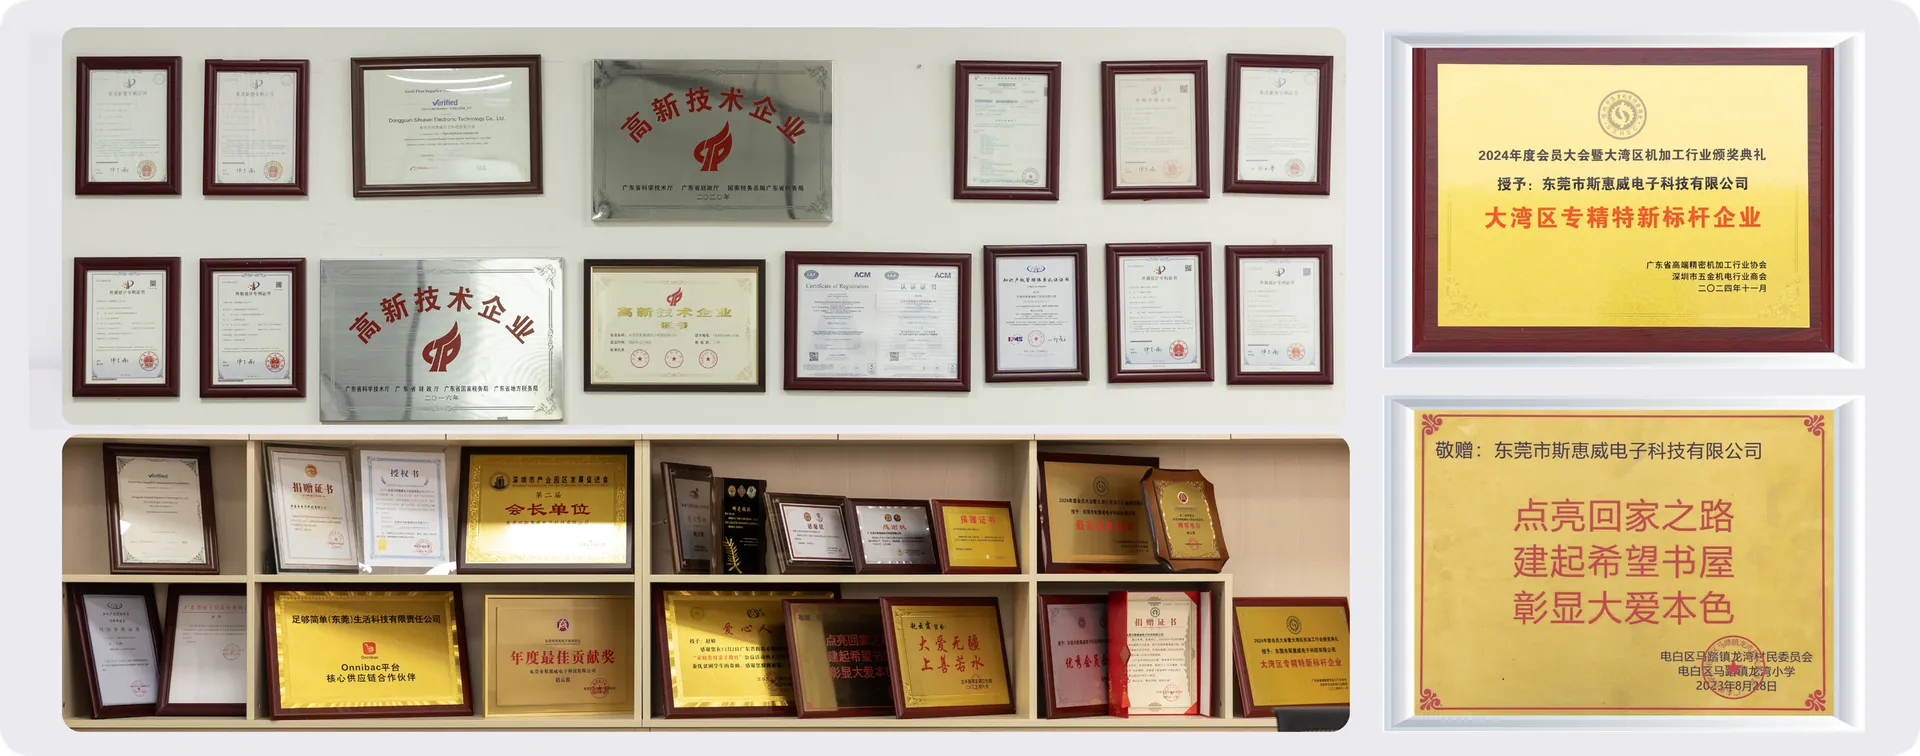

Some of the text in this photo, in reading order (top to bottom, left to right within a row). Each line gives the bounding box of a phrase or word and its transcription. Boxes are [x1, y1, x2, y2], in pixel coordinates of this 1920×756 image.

[620, 86, 806, 145] 高新技术企业
[1478, 148, 1767, 162] 2024年度会员大会暨大湾区机加工行业颁奖典礼
[1484, 206, 1762, 230] 大湾区专精特新标杆企业
[1646, 260, 1767, 270] 广东省高端精密机加工行业协会
[1672, 272, 1767, 281] 深圳市五金机电行业商会
[349, 285, 535, 345] 高新技术企业
[617, 306, 733, 318] 高新技术企业
[390, 468, 420, 478] 授权书
[292, 481, 334, 495] 捐赠证书
[505, 503, 591, 516] 会长单位
[1513, 498, 1735, 533] 点亮回家之路
[1513, 544, 1735, 579] 建起希望书屋
[1513, 590, 1735, 626] 彰显大爱本色
[722, 621, 786, 636] 爱心人
[1134, 617, 1177, 627] 捐赠证书
[826, 633, 882, 647] 点亮回家之
[918, 634, 981, 653] 大爱无疆
[510, 649, 616, 666] 年度最佳贡献奖
[828, 649, 885, 663] 建起希望书
[1259, 657, 1343, 669] 大湾区专精特新标杆企业
[341, 662, 400, 672] Onnibac平台
[921, 655, 985, 674] 上善若水
[327, 673, 416, 683] 核心供应链合作伙伴
[830, 665, 891, 679] 彰显大爱本
[1695, 680, 1777, 692] 2023年8月28日
